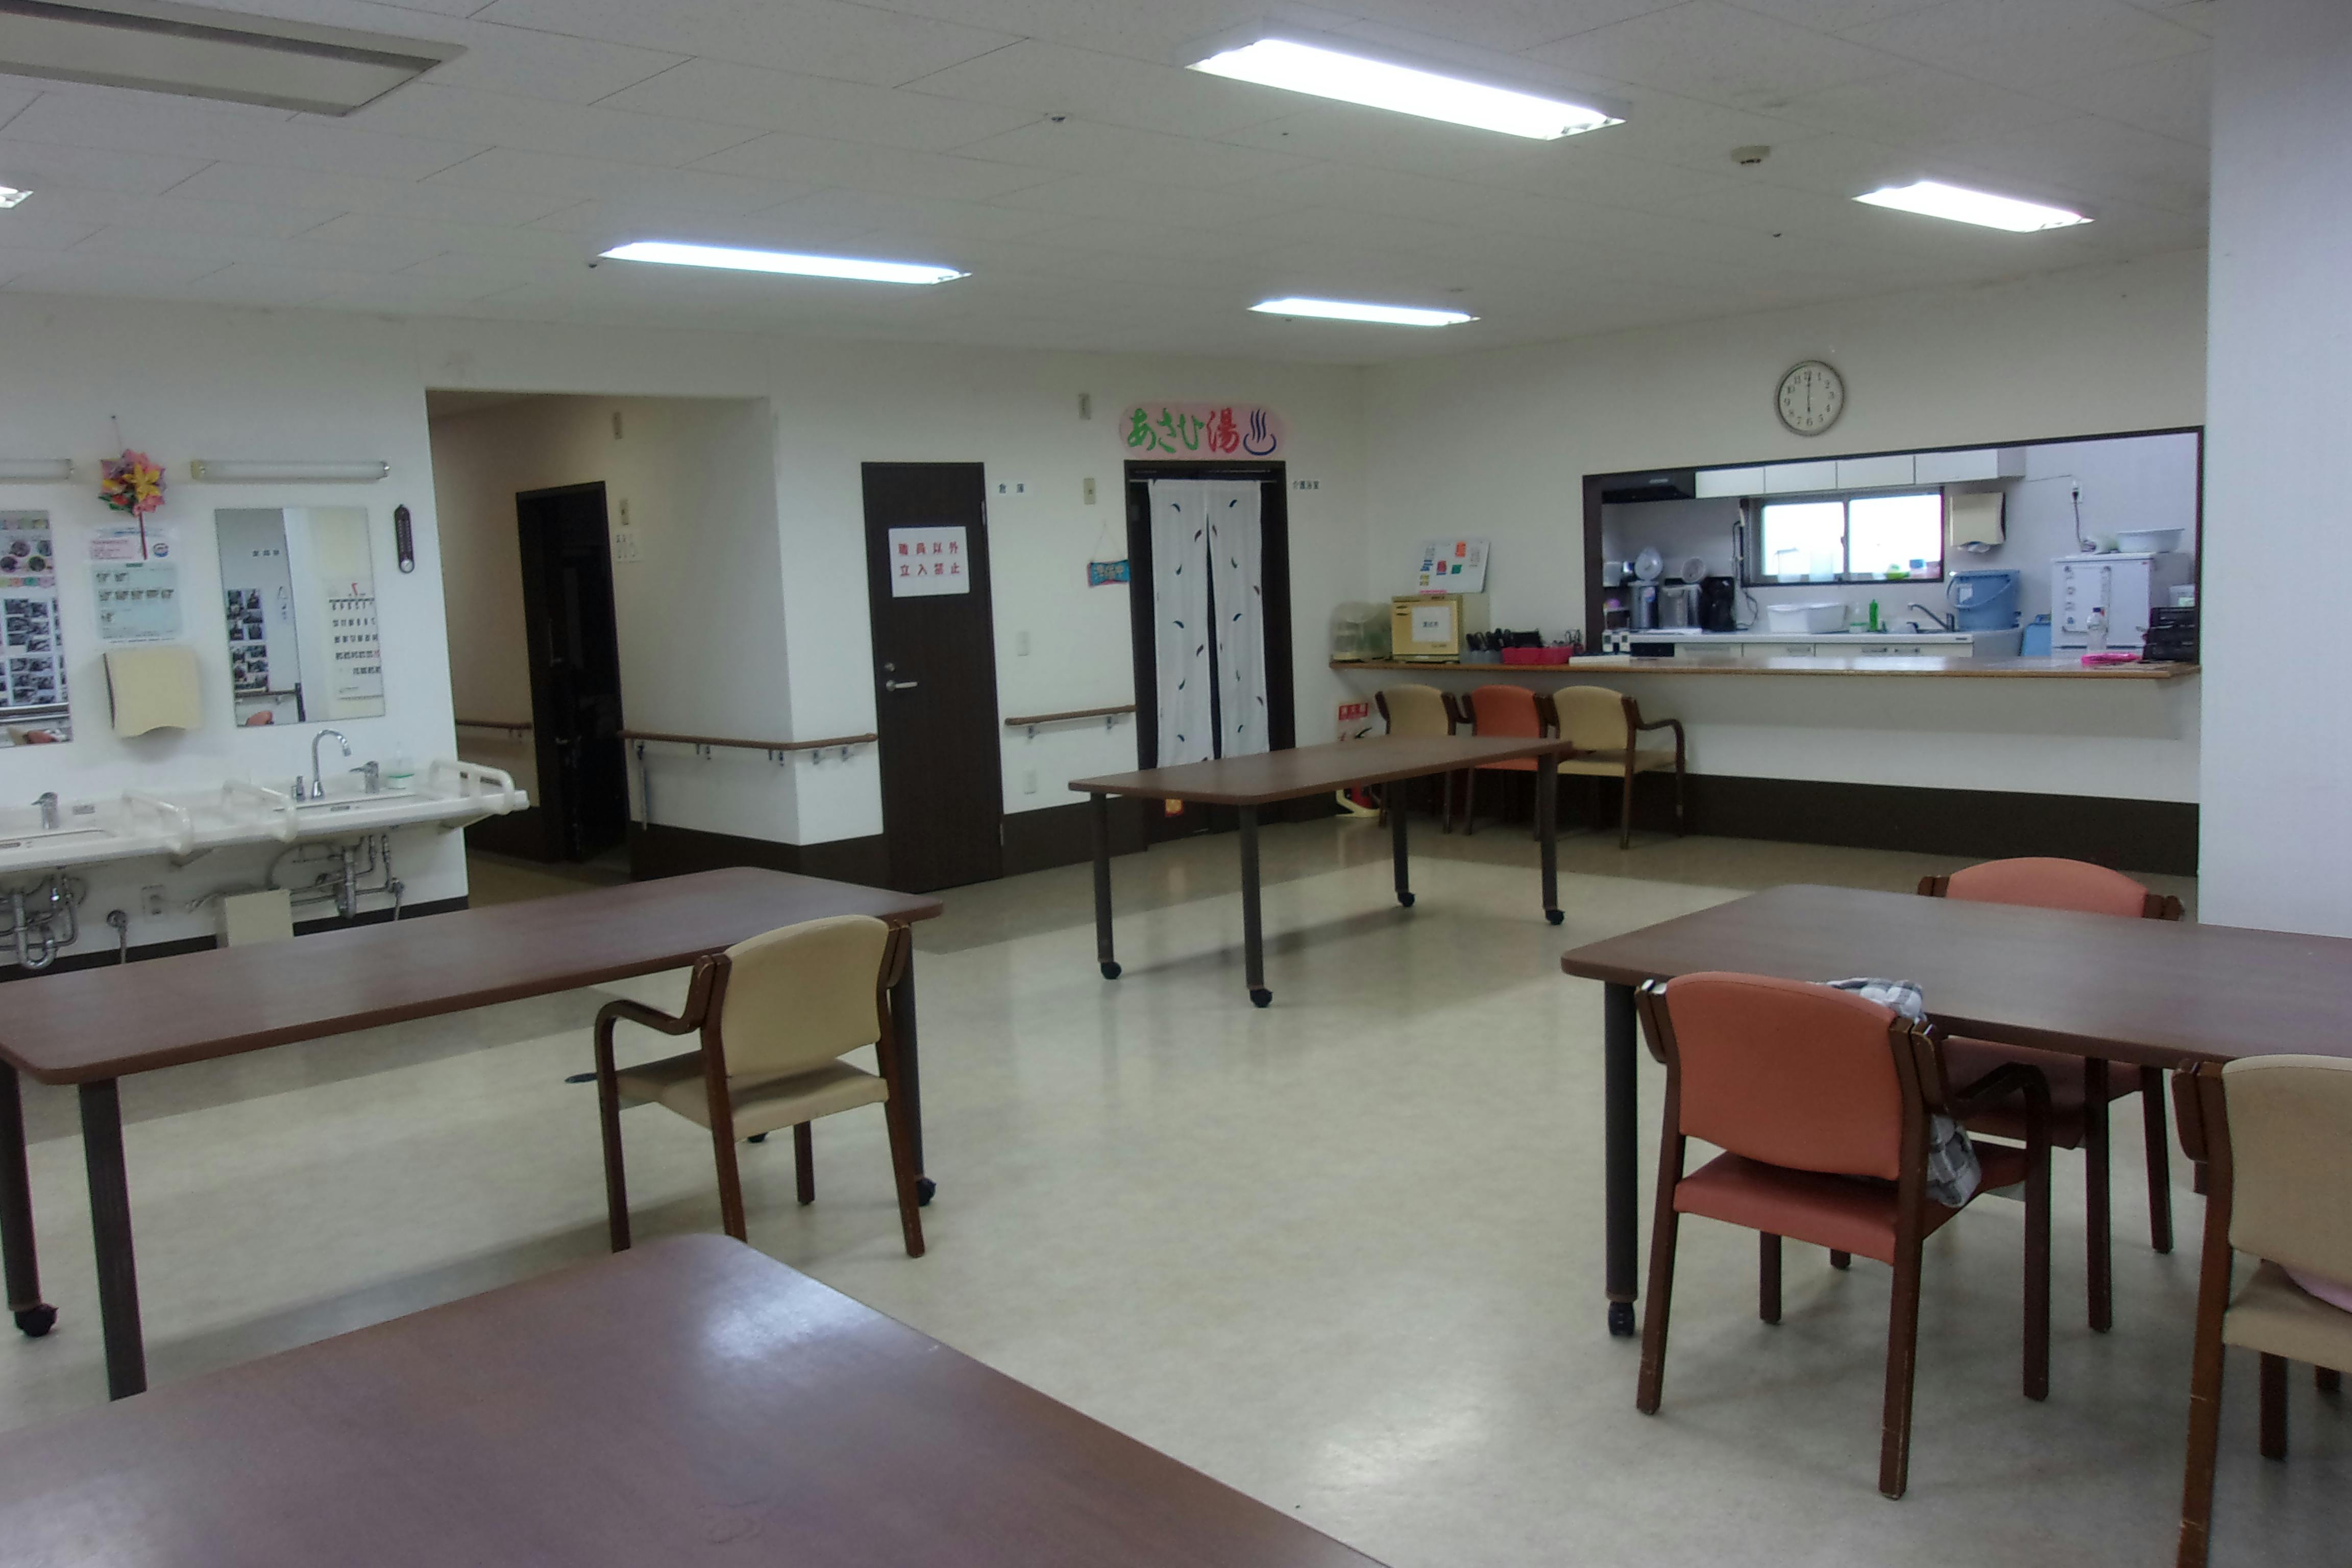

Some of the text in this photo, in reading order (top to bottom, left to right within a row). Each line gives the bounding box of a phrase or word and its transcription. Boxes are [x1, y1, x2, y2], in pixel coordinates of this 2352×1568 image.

[1128, 407, 1240, 453] あさひ湯
[900, 562, 960, 576] 立入禁止
